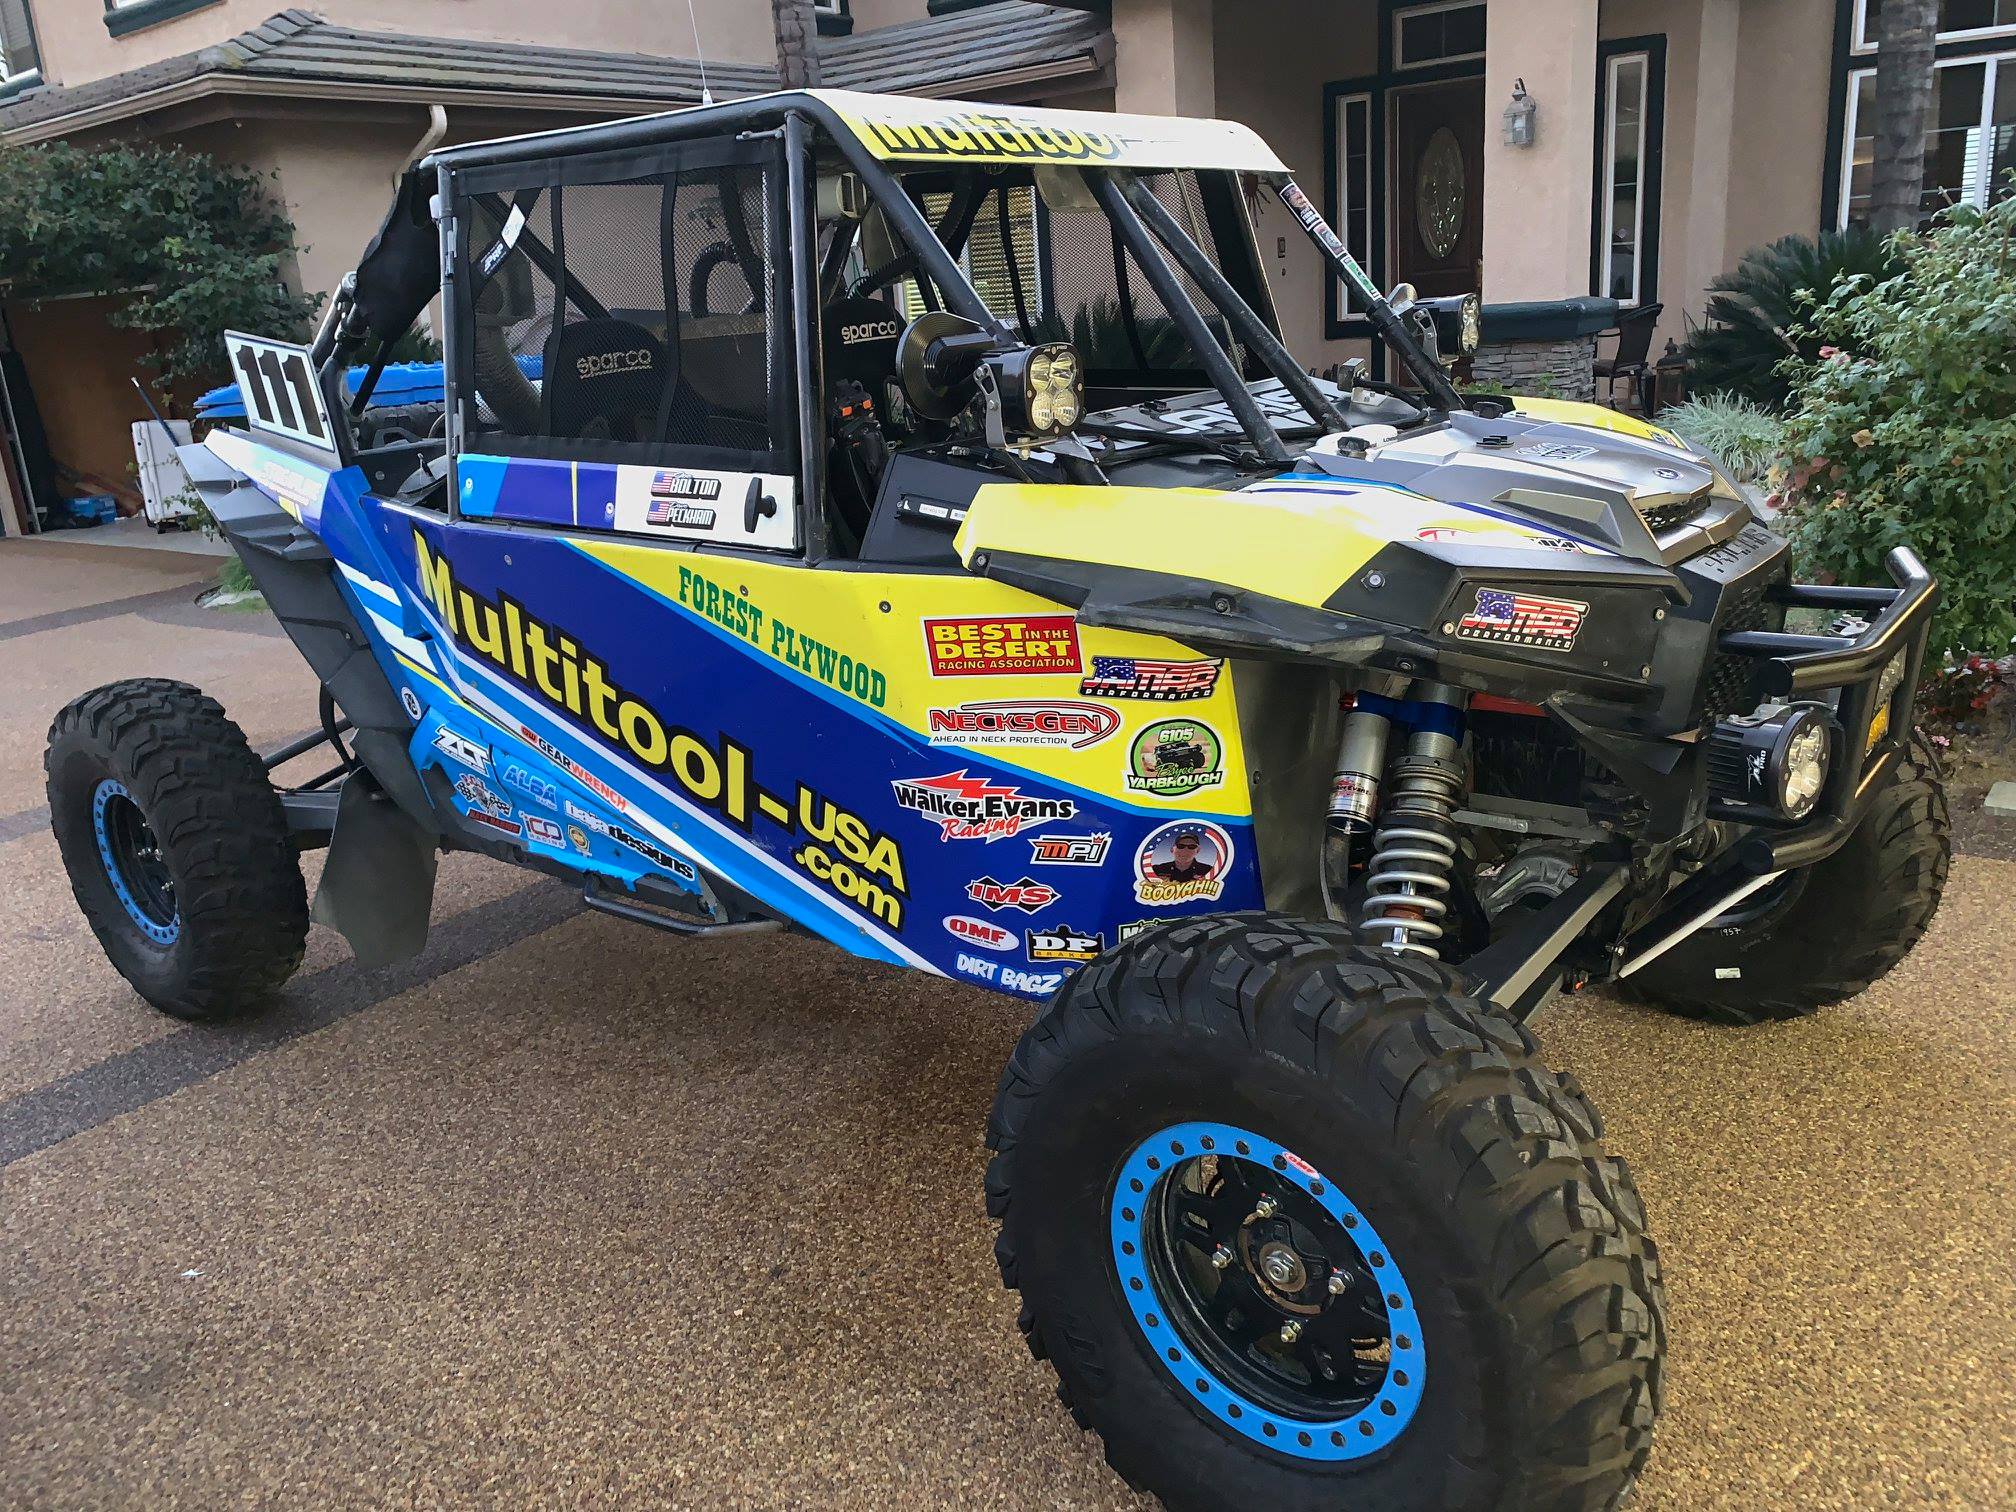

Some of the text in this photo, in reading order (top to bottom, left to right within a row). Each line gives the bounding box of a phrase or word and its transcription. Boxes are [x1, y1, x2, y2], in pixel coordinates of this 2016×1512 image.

[842, 321, 897, 345] sparco
[576, 349, 652, 374] sparco
[236, 345, 325, 439] 111
[669, 478, 719, 496] BOLTON
[666, 509, 714, 526] PECKHAM
[678, 565, 887, 708] FOREST PLYWOOD
[932, 624, 1070, 642] BEST IN THE
[1462, 628, 1572, 649] PERFORMANCE
[936, 640, 1072, 659] DESERT
[938, 658, 1075, 670] RACING ASSOCIATION
[1085, 687, 1212, 700] PERFORMANCE
[1159, 728, 1194, 743] 6105
[1128, 772, 1221, 789] YARBROUGH
[894, 786, 1072, 818] Walker Evans
[941, 816, 1020, 842] Racing
[796, 846, 900, 929] .com
[972, 885, 1052, 905] IMS
[1139, 880, 1220, 901] BOOYAH!!!
[949, 918, 1006, 943] OMF
[1032, 935, 1098, 952] DP
[956, 953, 1062, 995] DIRT BAGZ
